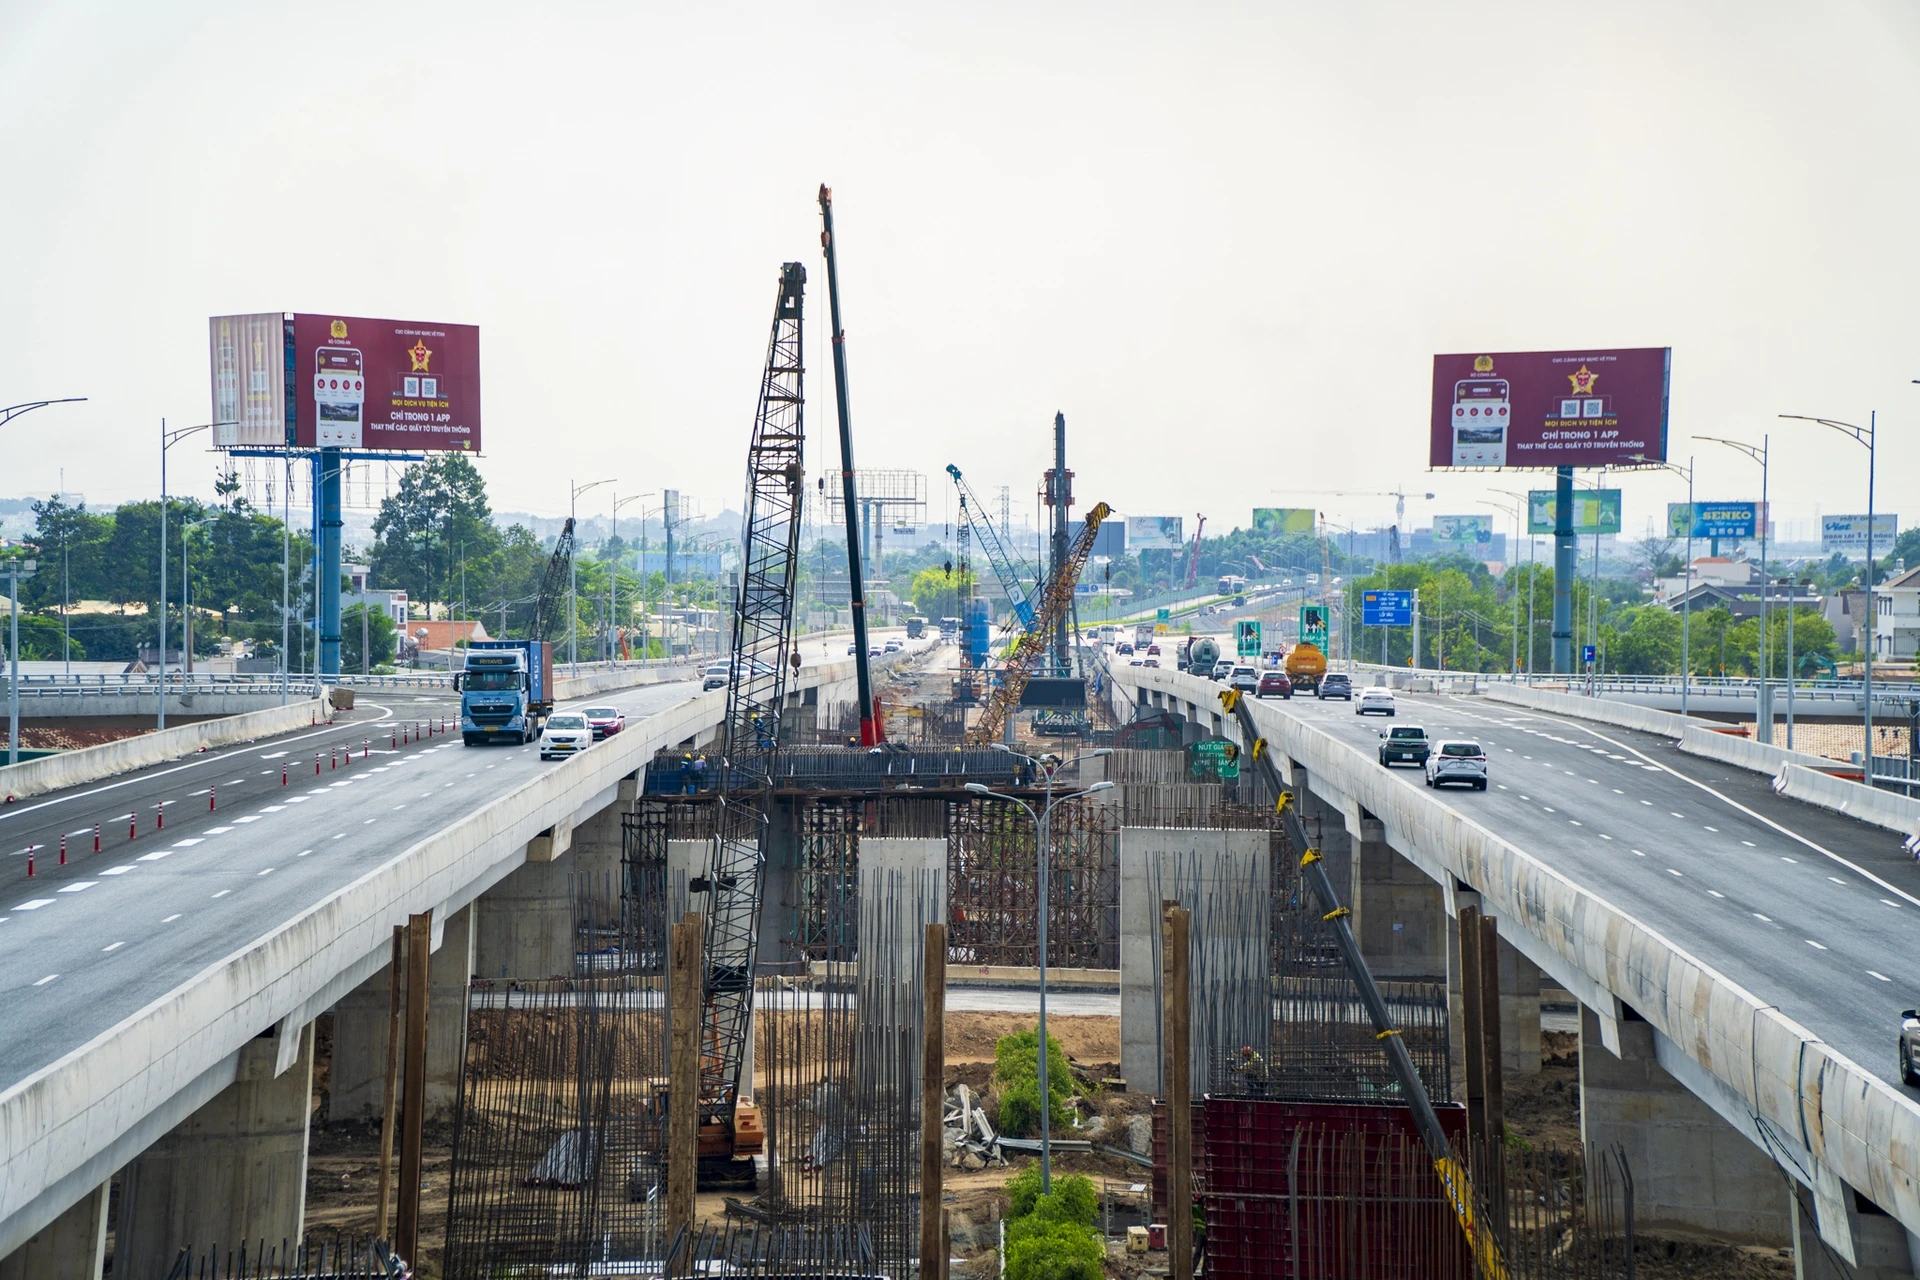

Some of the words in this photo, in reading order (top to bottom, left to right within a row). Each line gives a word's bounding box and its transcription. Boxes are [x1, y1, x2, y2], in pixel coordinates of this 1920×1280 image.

[391, 410, 403, 420] CHỈ
[404, 412, 429, 421] TRONG
[385, 422, 395, 431] THẾ
[395, 423, 407, 432] CÁC
[409, 423, 422, 432] GIẤY
[431, 424, 450, 433] TRUYỀN
[452, 424, 470, 433] THỐNG
[1542, 430, 1558, 440] CHỈ
[1560, 431, 1590, 439] TRONG
[1703, 511, 1751, 520] SENKO
